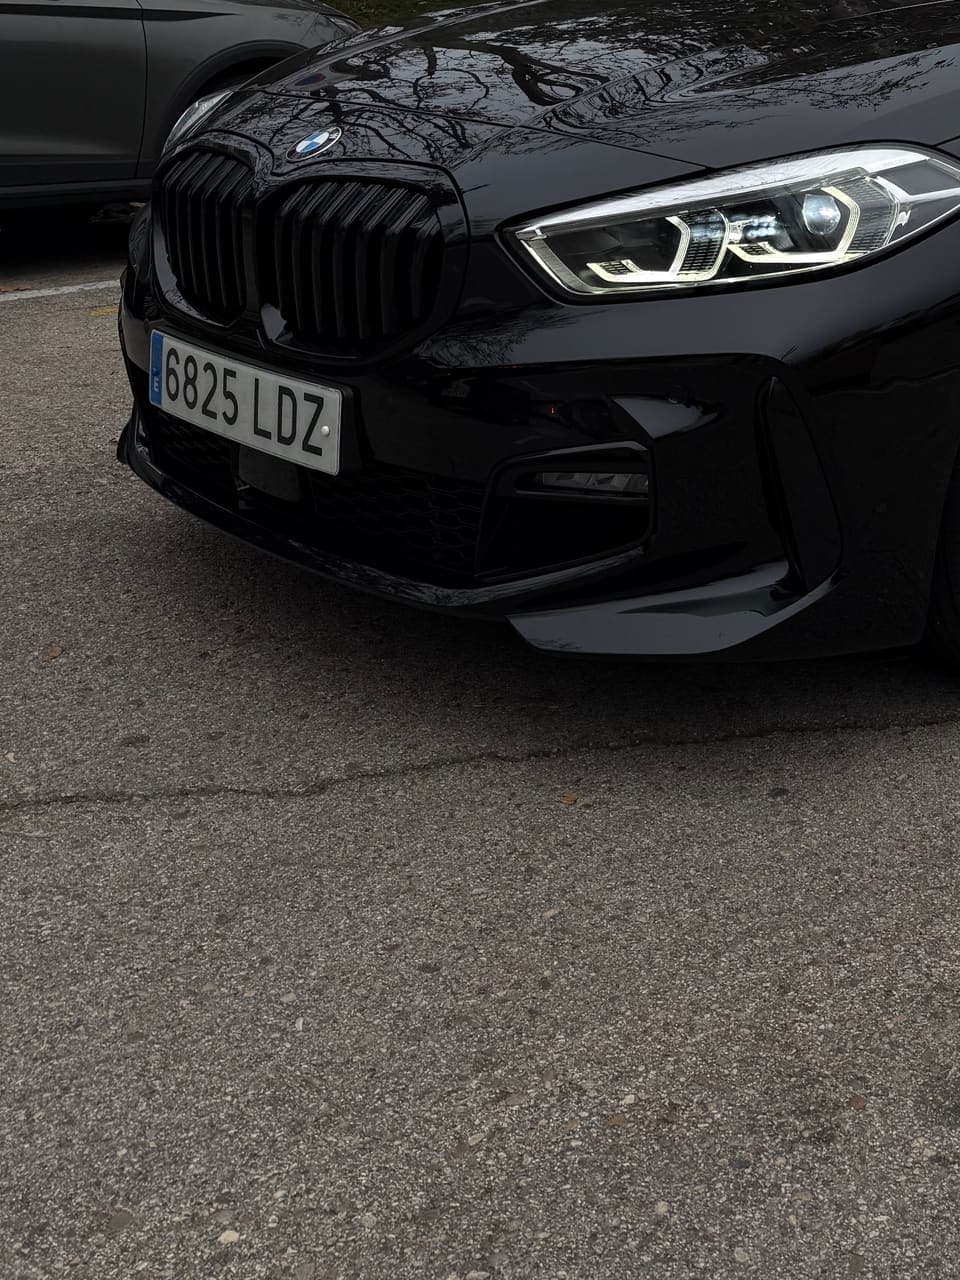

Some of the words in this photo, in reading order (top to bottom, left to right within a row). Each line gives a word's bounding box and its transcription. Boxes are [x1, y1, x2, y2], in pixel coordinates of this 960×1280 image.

[153, 376, 160, 393] E
[166, 347, 239, 426] 6825
[253, 378, 324, 457] LDZ
